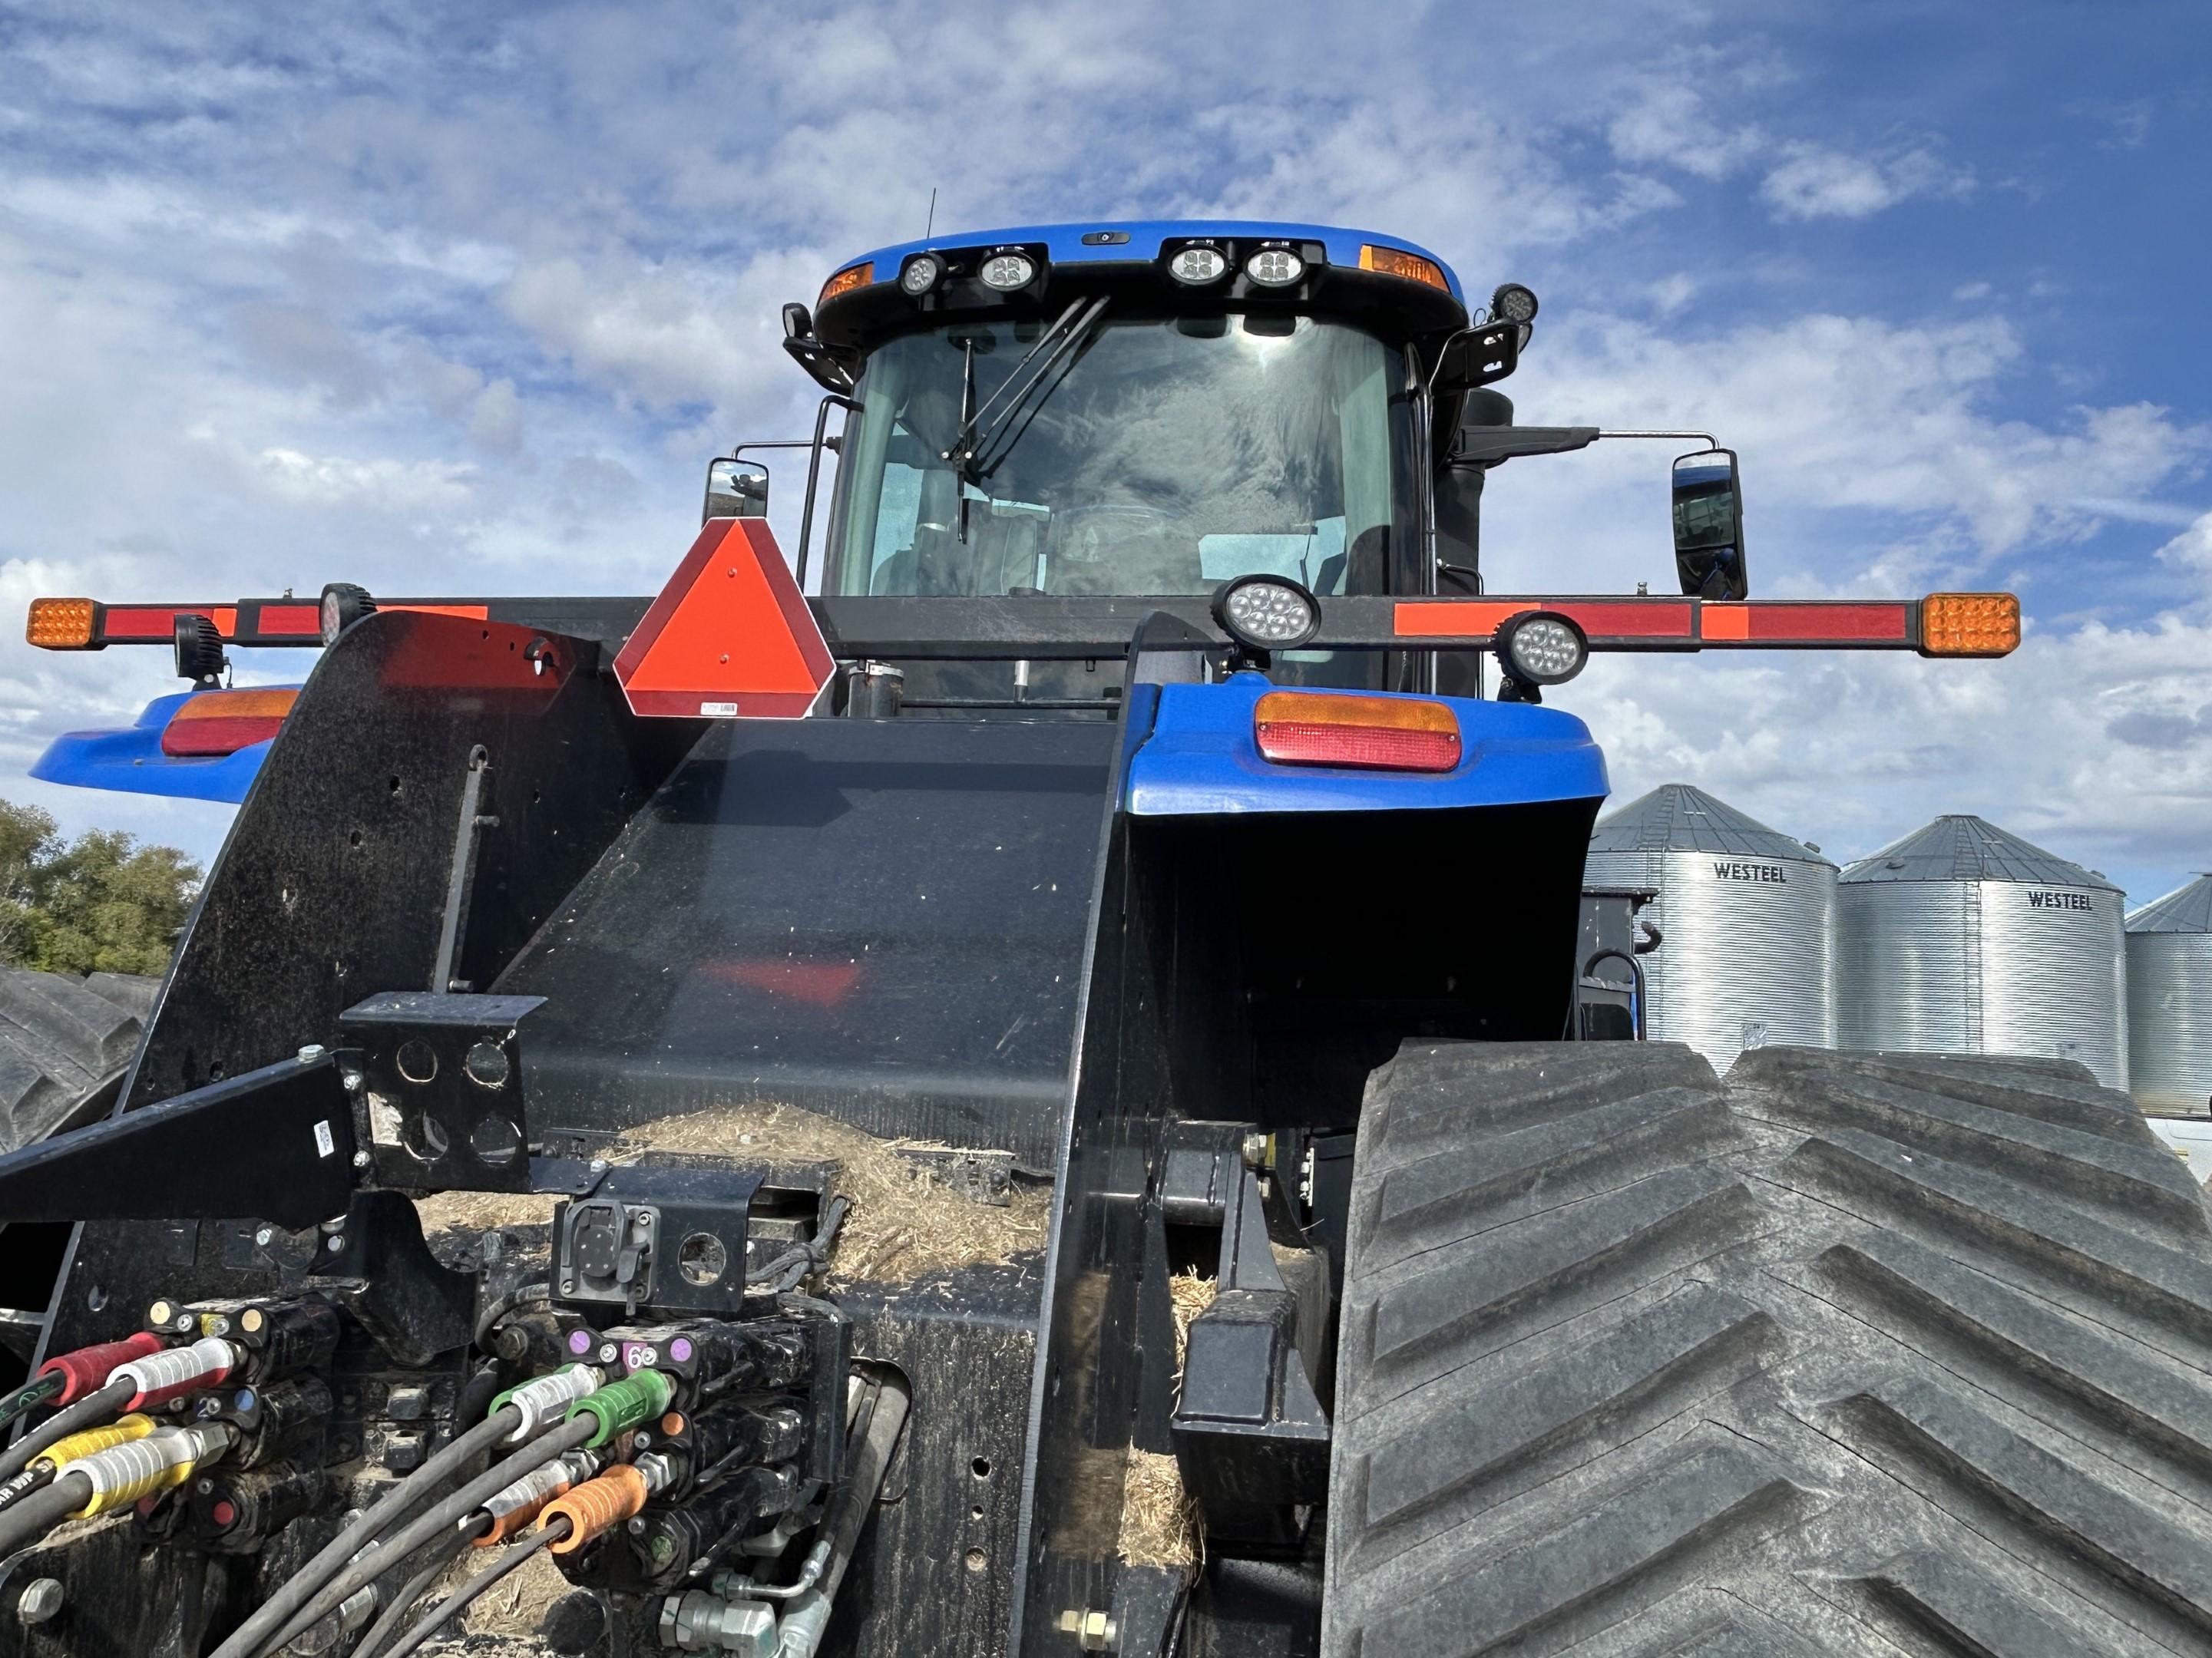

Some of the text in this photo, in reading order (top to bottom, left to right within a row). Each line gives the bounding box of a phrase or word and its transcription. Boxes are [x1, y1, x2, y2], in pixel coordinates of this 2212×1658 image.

[1714, 863, 1787, 883] WESTEEL
[2028, 891, 2093, 911] WESTEEL
[628, 1346, 643, 1369] 6
